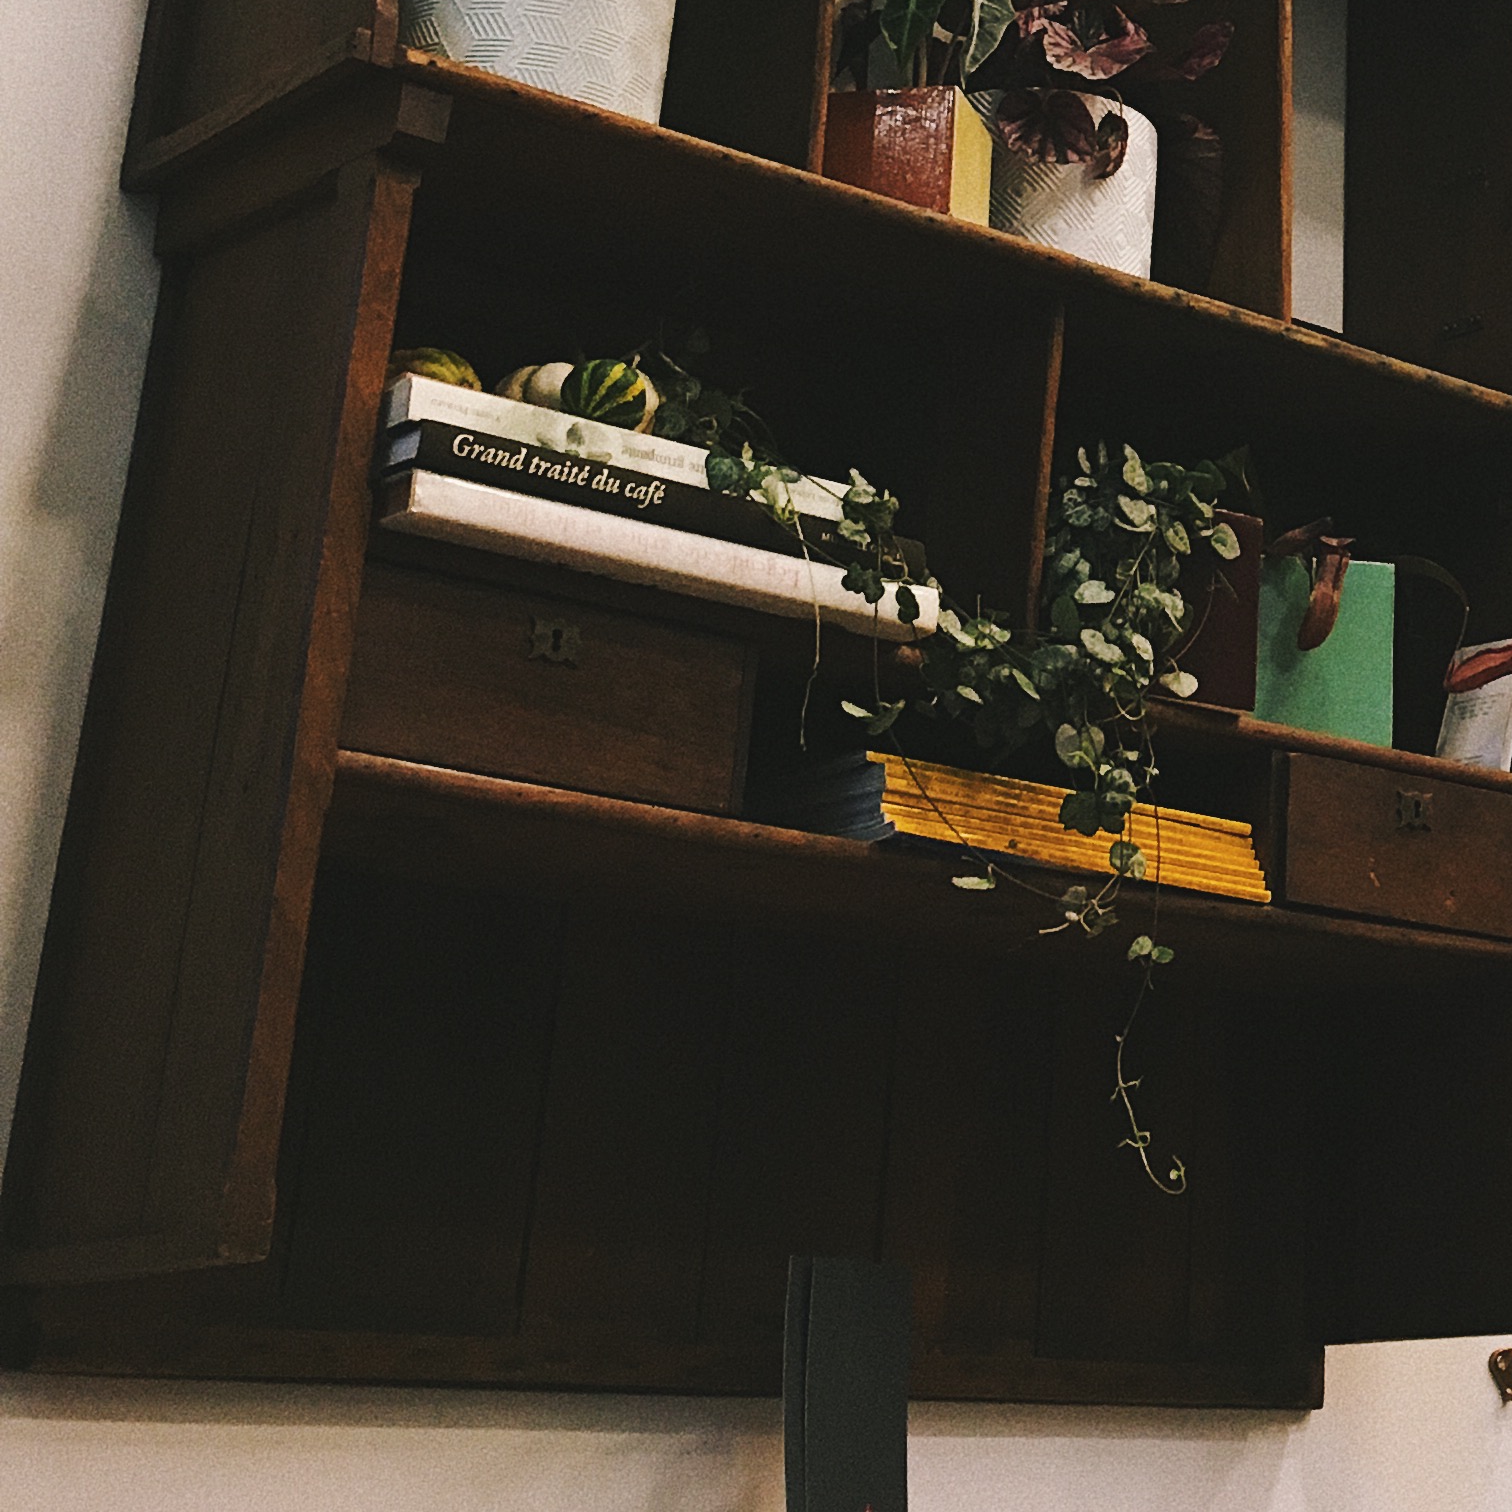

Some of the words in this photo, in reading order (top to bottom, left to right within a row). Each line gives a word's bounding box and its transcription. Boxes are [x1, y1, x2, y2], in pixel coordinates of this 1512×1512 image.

[452, 433, 525, 472] Grand
[529, 454, 589, 487] traité
[591, 467, 621, 494] du
[624, 478, 666, 507] café
